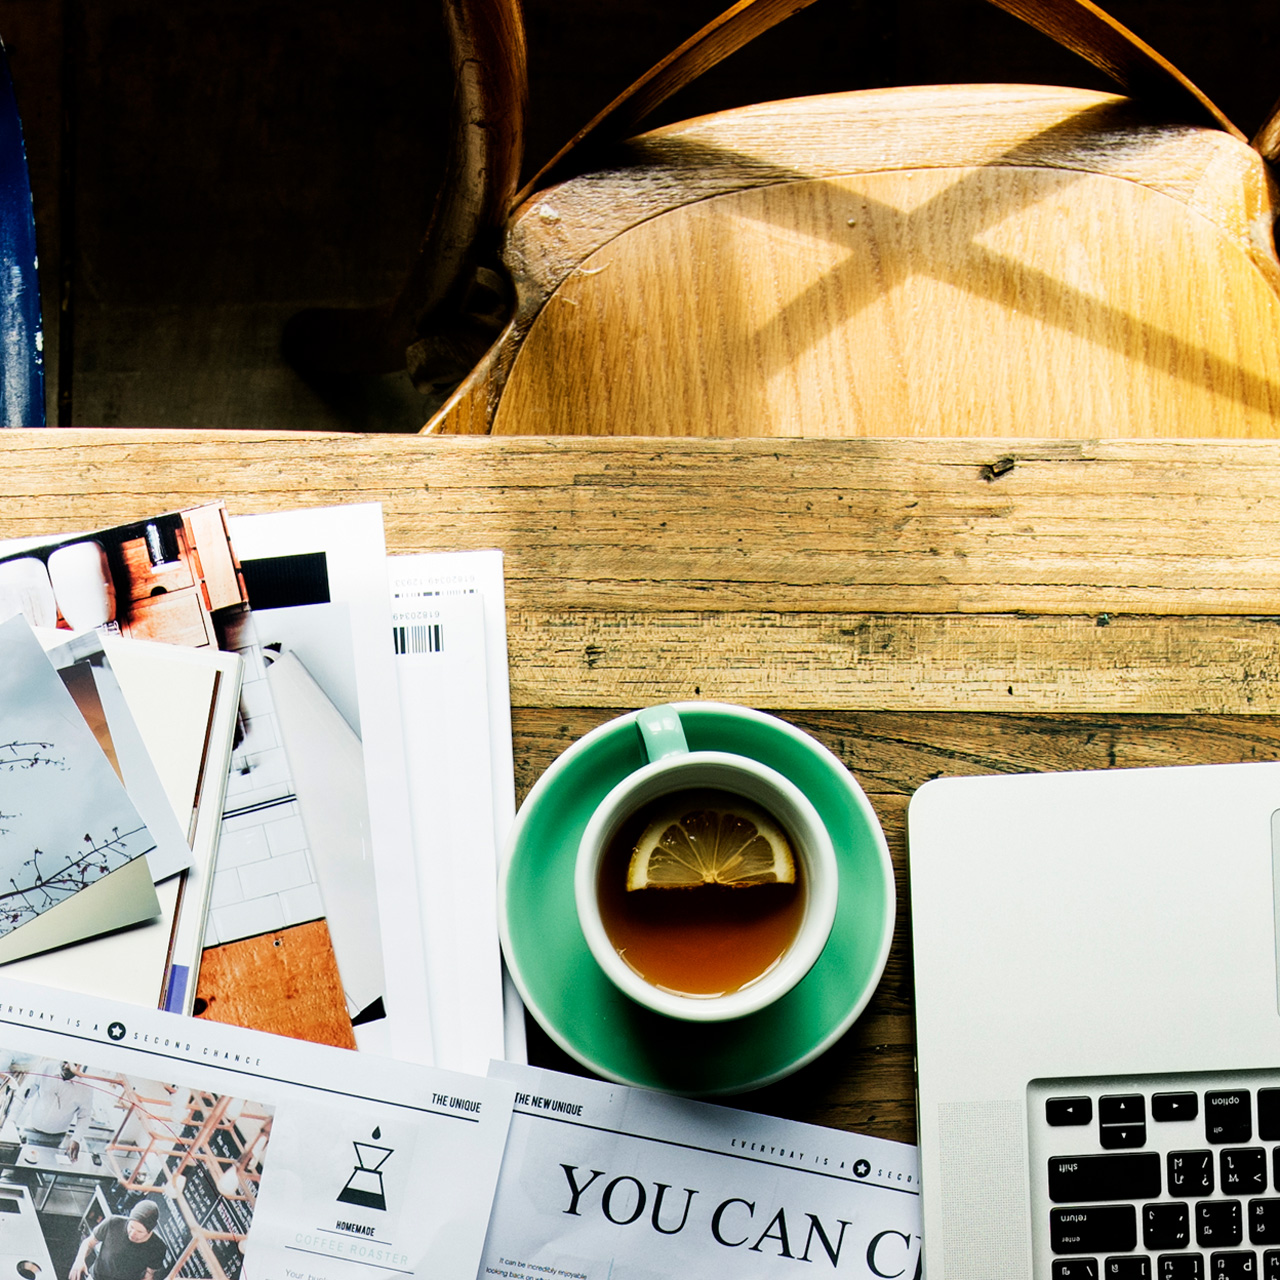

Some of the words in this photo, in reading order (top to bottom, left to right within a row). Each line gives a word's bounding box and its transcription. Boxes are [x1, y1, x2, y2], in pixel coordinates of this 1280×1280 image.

[392, 609, 441, 622] 61820349
[67, 1018, 80, 1028] IS
[93, 1023, 99, 1032] A
[133, 1032, 191, 1051] SECOND
[203, 1047, 260, 1066] CHANCE
[432, 1092, 449, 1107] THE
[449, 1096, 482, 1114] UNIQUE
[514, 1092, 531, 1106] THE
[530, 1095, 552, 1110] NEW
[551, 1100, 584, 1117] UNIQUE
[1211, 1095, 1240, 1106] option
[731, 1138, 804, 1160] EVERYDAY
[815, 1156, 829, 1166] IS
[839, 1161, 846, 1170] A
[1058, 1163, 1078, 1173] shift
[559, 1163, 700, 1235] YOU
[711, 1198, 853, 1269] CAN
[1060, 1214, 1087, 1223] return
[335, 1220, 376, 1237] HOMEMADE
[294, 1232, 344, 1253] COFFEE
[349, 1244, 408, 1265] ROASTER
